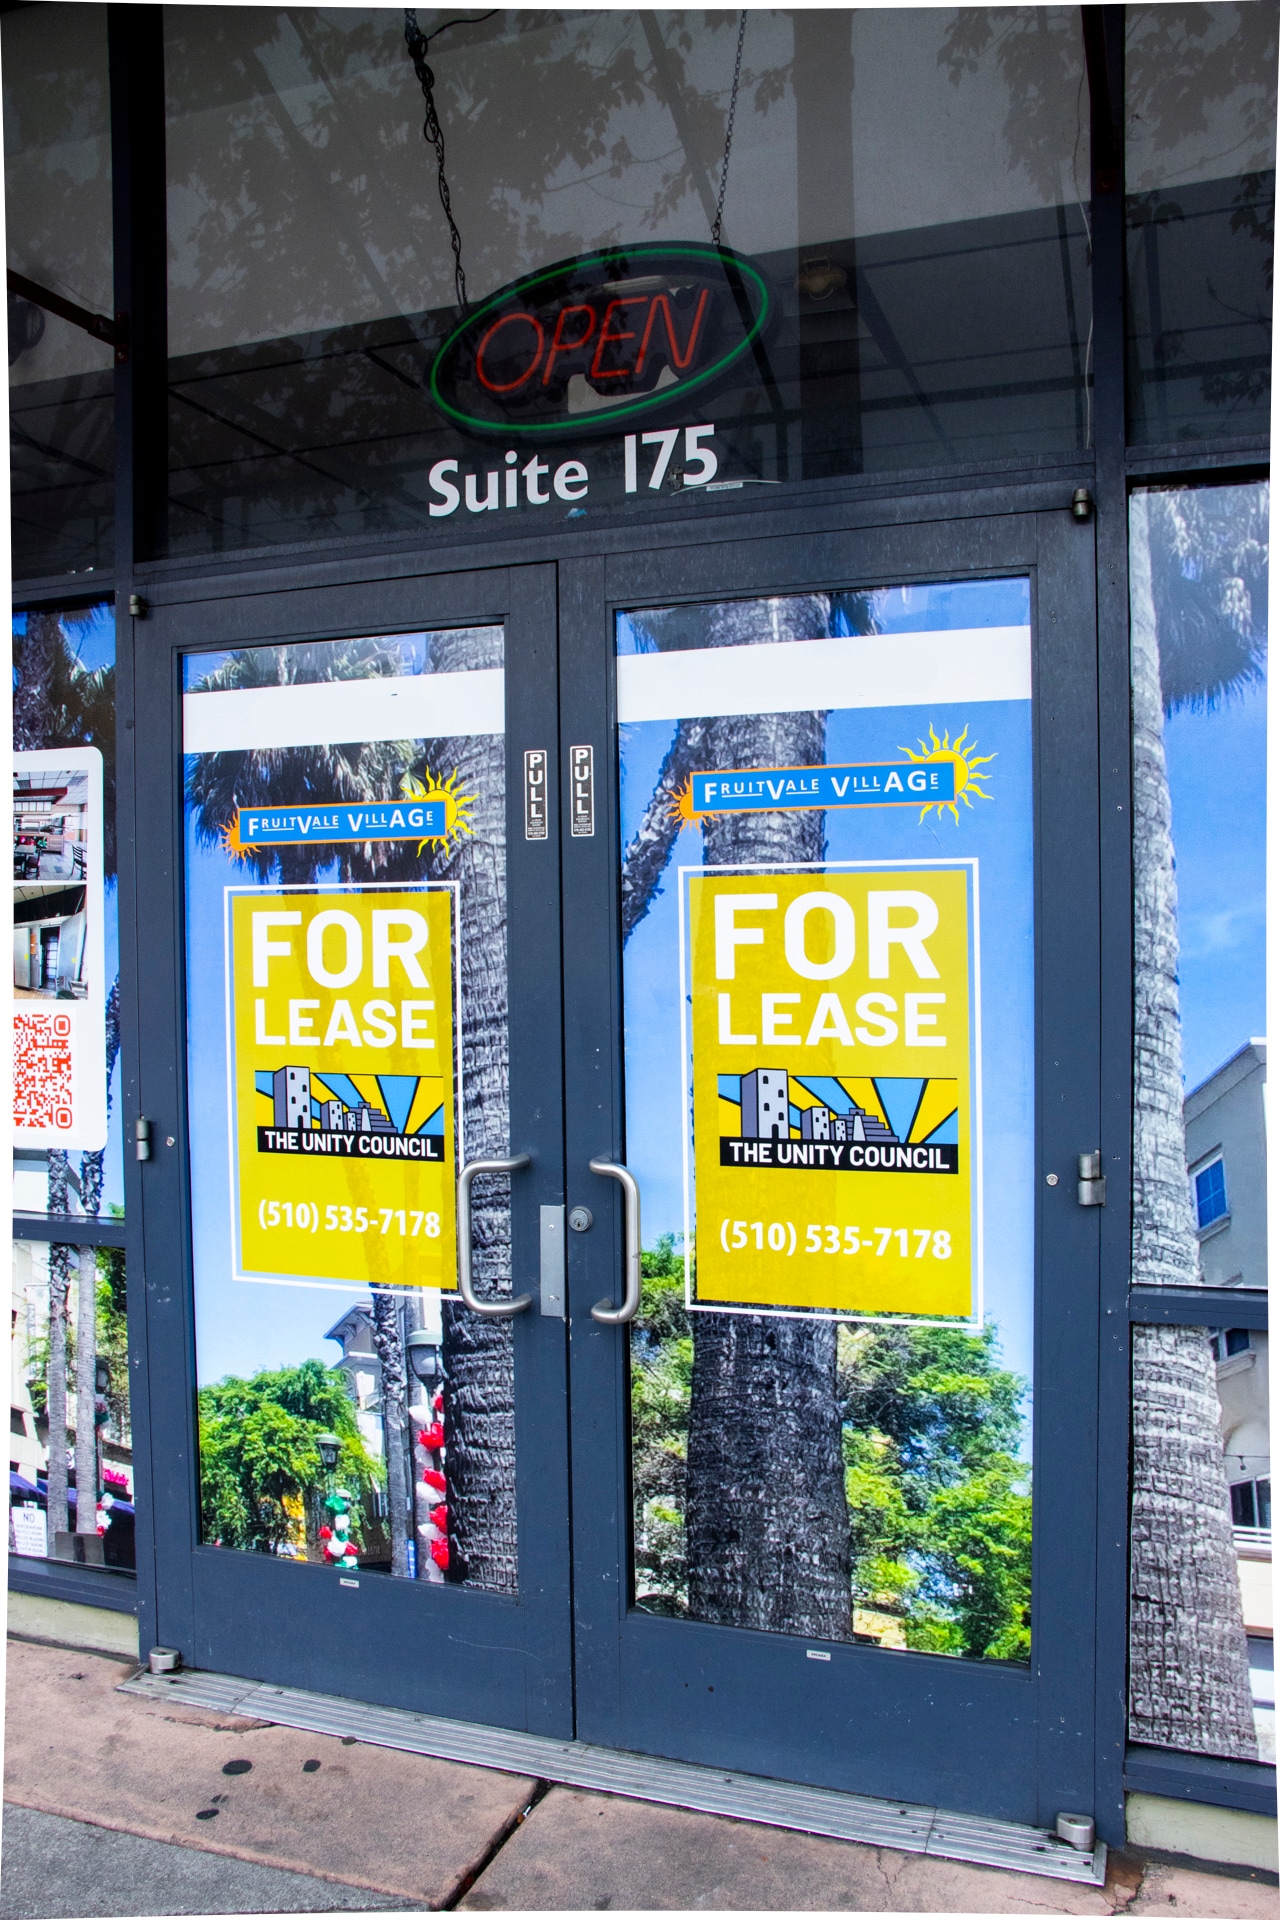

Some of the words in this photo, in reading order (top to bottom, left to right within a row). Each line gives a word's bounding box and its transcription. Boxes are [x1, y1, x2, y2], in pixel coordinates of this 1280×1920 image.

[476, 289, 708, 392] OPEN
[428, 450, 589, 517] Suite
[624, 424, 718, 493] 175
[528, 753, 543, 818] PULL
[574, 749, 589, 814] PULL
[704, 777, 820, 803] FRUITVALE
[831, 770, 939, 797] VILLAGE
[248, 814, 339, 836] FRUITVALE
[348, 808, 434, 832] VILLAGE
[252, 909, 430, 988] FOR
[714, 890, 941, 980] FOR
[255, 998, 435, 1048] LEASE
[718, 992, 947, 1047] LEASE
[264, 1130, 299, 1150] THE
[302, 1133, 354, 1153] UNITY
[358, 1136, 438, 1158] COUNCIL
[729, 1142, 772, 1164] THE
[777, 1144, 845, 1166] UNITY
[849, 1146, 950, 1169] COUNCIL
[258, 1199, 319, 1233] (510)
[325, 1204, 441, 1238] 535-7178
[720, 1218, 797, 1256] (510)
[805, 1225, 952, 1260] 535-7178
[23, 1512, 35, 1523] NO
